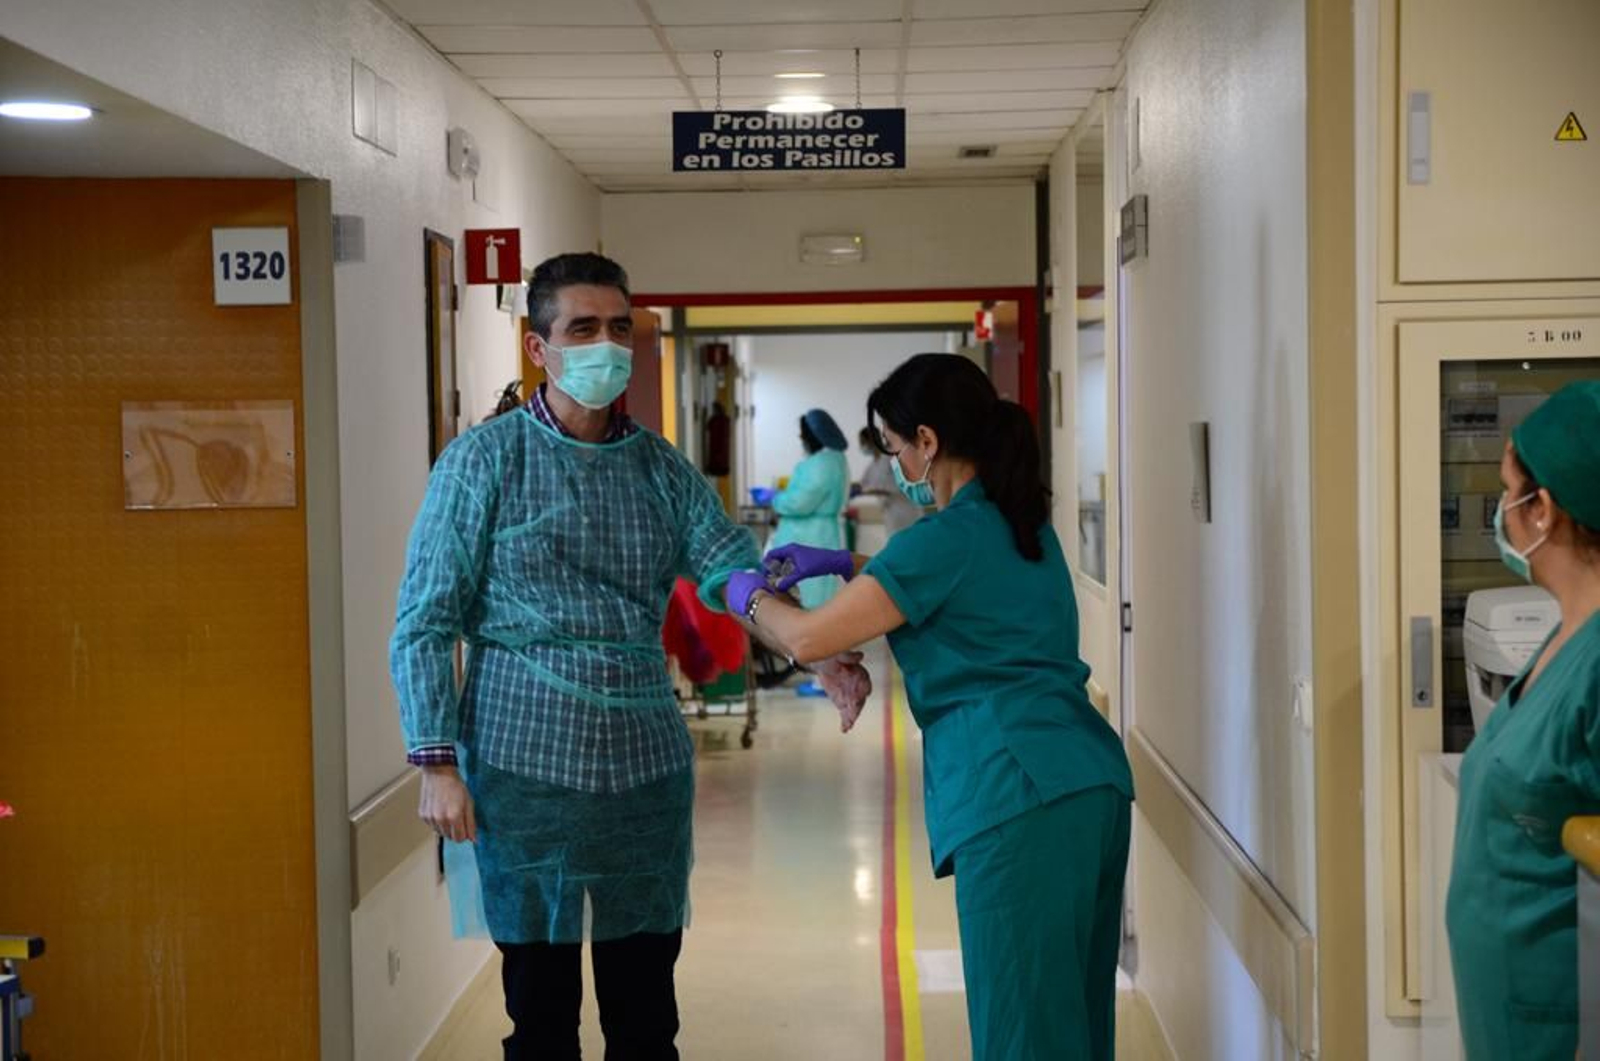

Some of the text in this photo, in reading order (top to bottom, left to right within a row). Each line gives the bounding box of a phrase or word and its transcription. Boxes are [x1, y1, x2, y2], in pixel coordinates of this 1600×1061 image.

[713, 112, 864, 130] Prohibido
[699, 132, 879, 149] Permanecer
[683, 150, 896, 168] en los Pasillos
[219, 250, 286, 281] 1320
